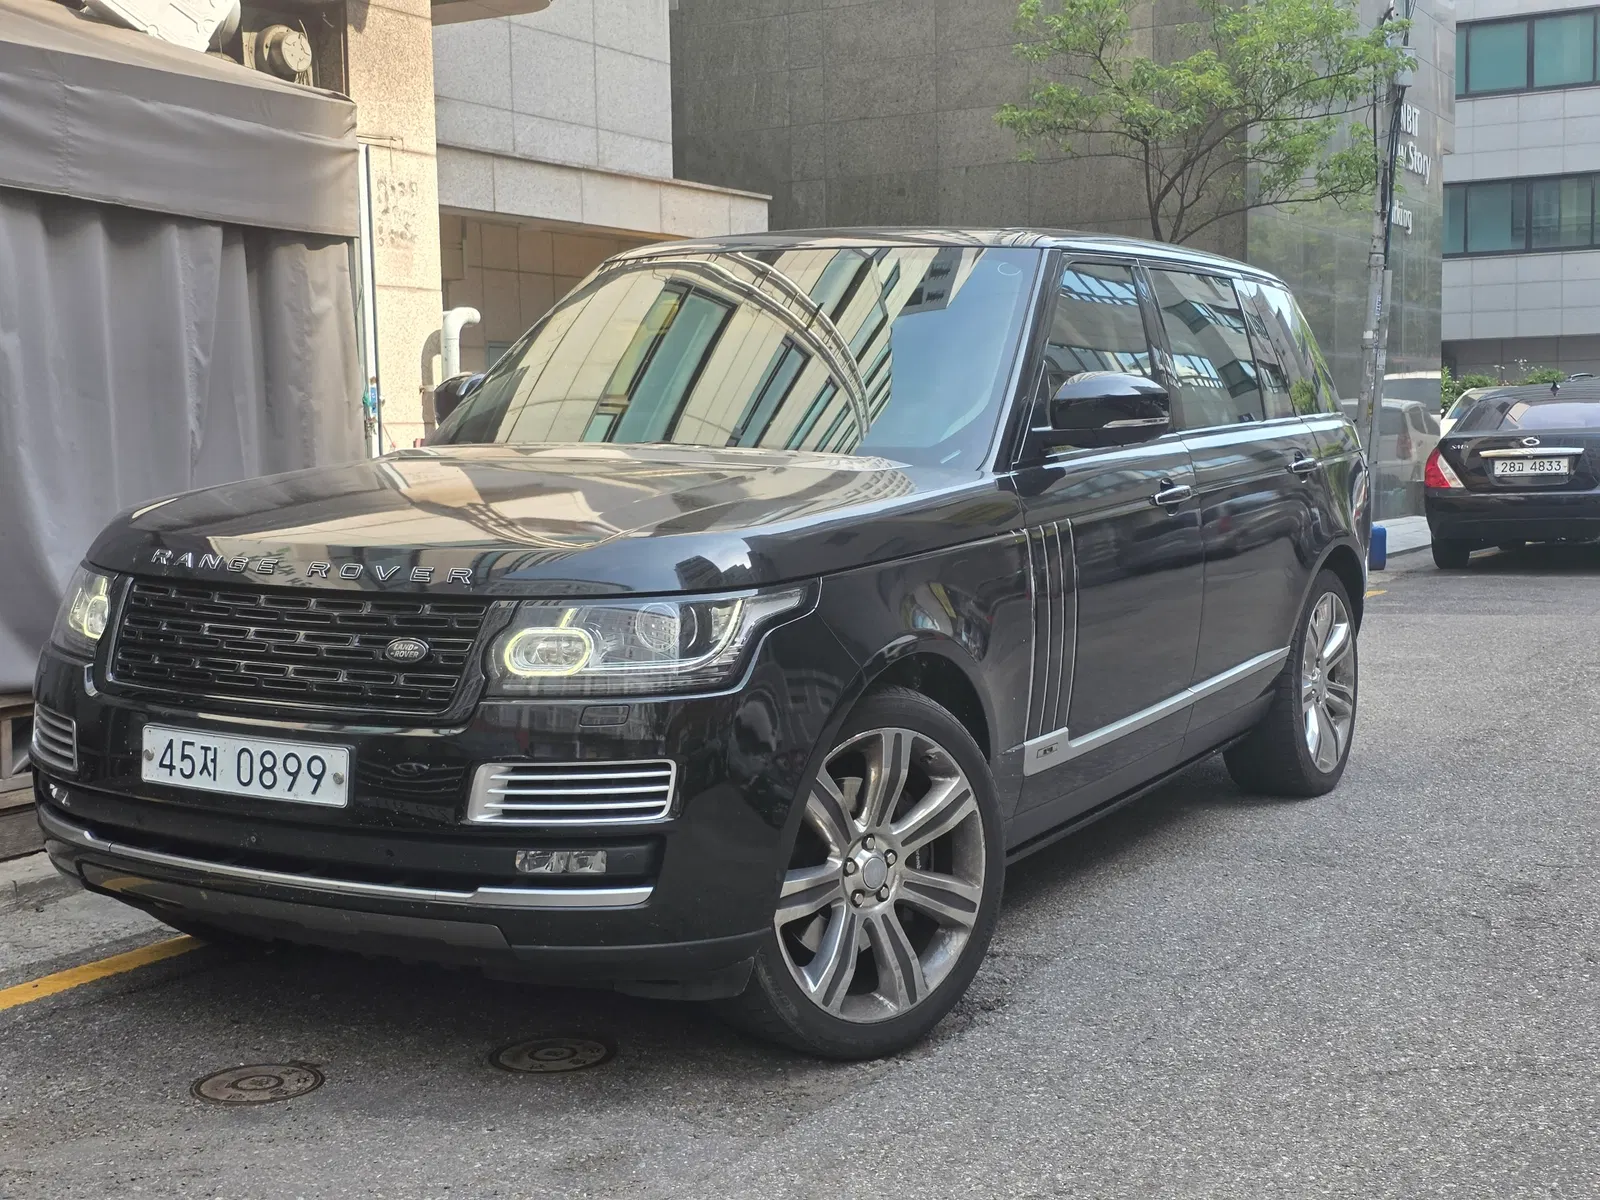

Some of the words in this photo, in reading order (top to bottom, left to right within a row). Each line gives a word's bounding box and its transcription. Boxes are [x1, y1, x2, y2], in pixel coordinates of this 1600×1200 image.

[1407, 141, 1431, 184] Story
[1530, 460, 1562, 472] 4833
[150, 548, 279, 575] RANGE
[306, 561, 473, 584] ROVER
[393, 650, 419, 658] ROVER
[158, 738, 218, 782] 45저
[236, 747, 327, 795] 0899
